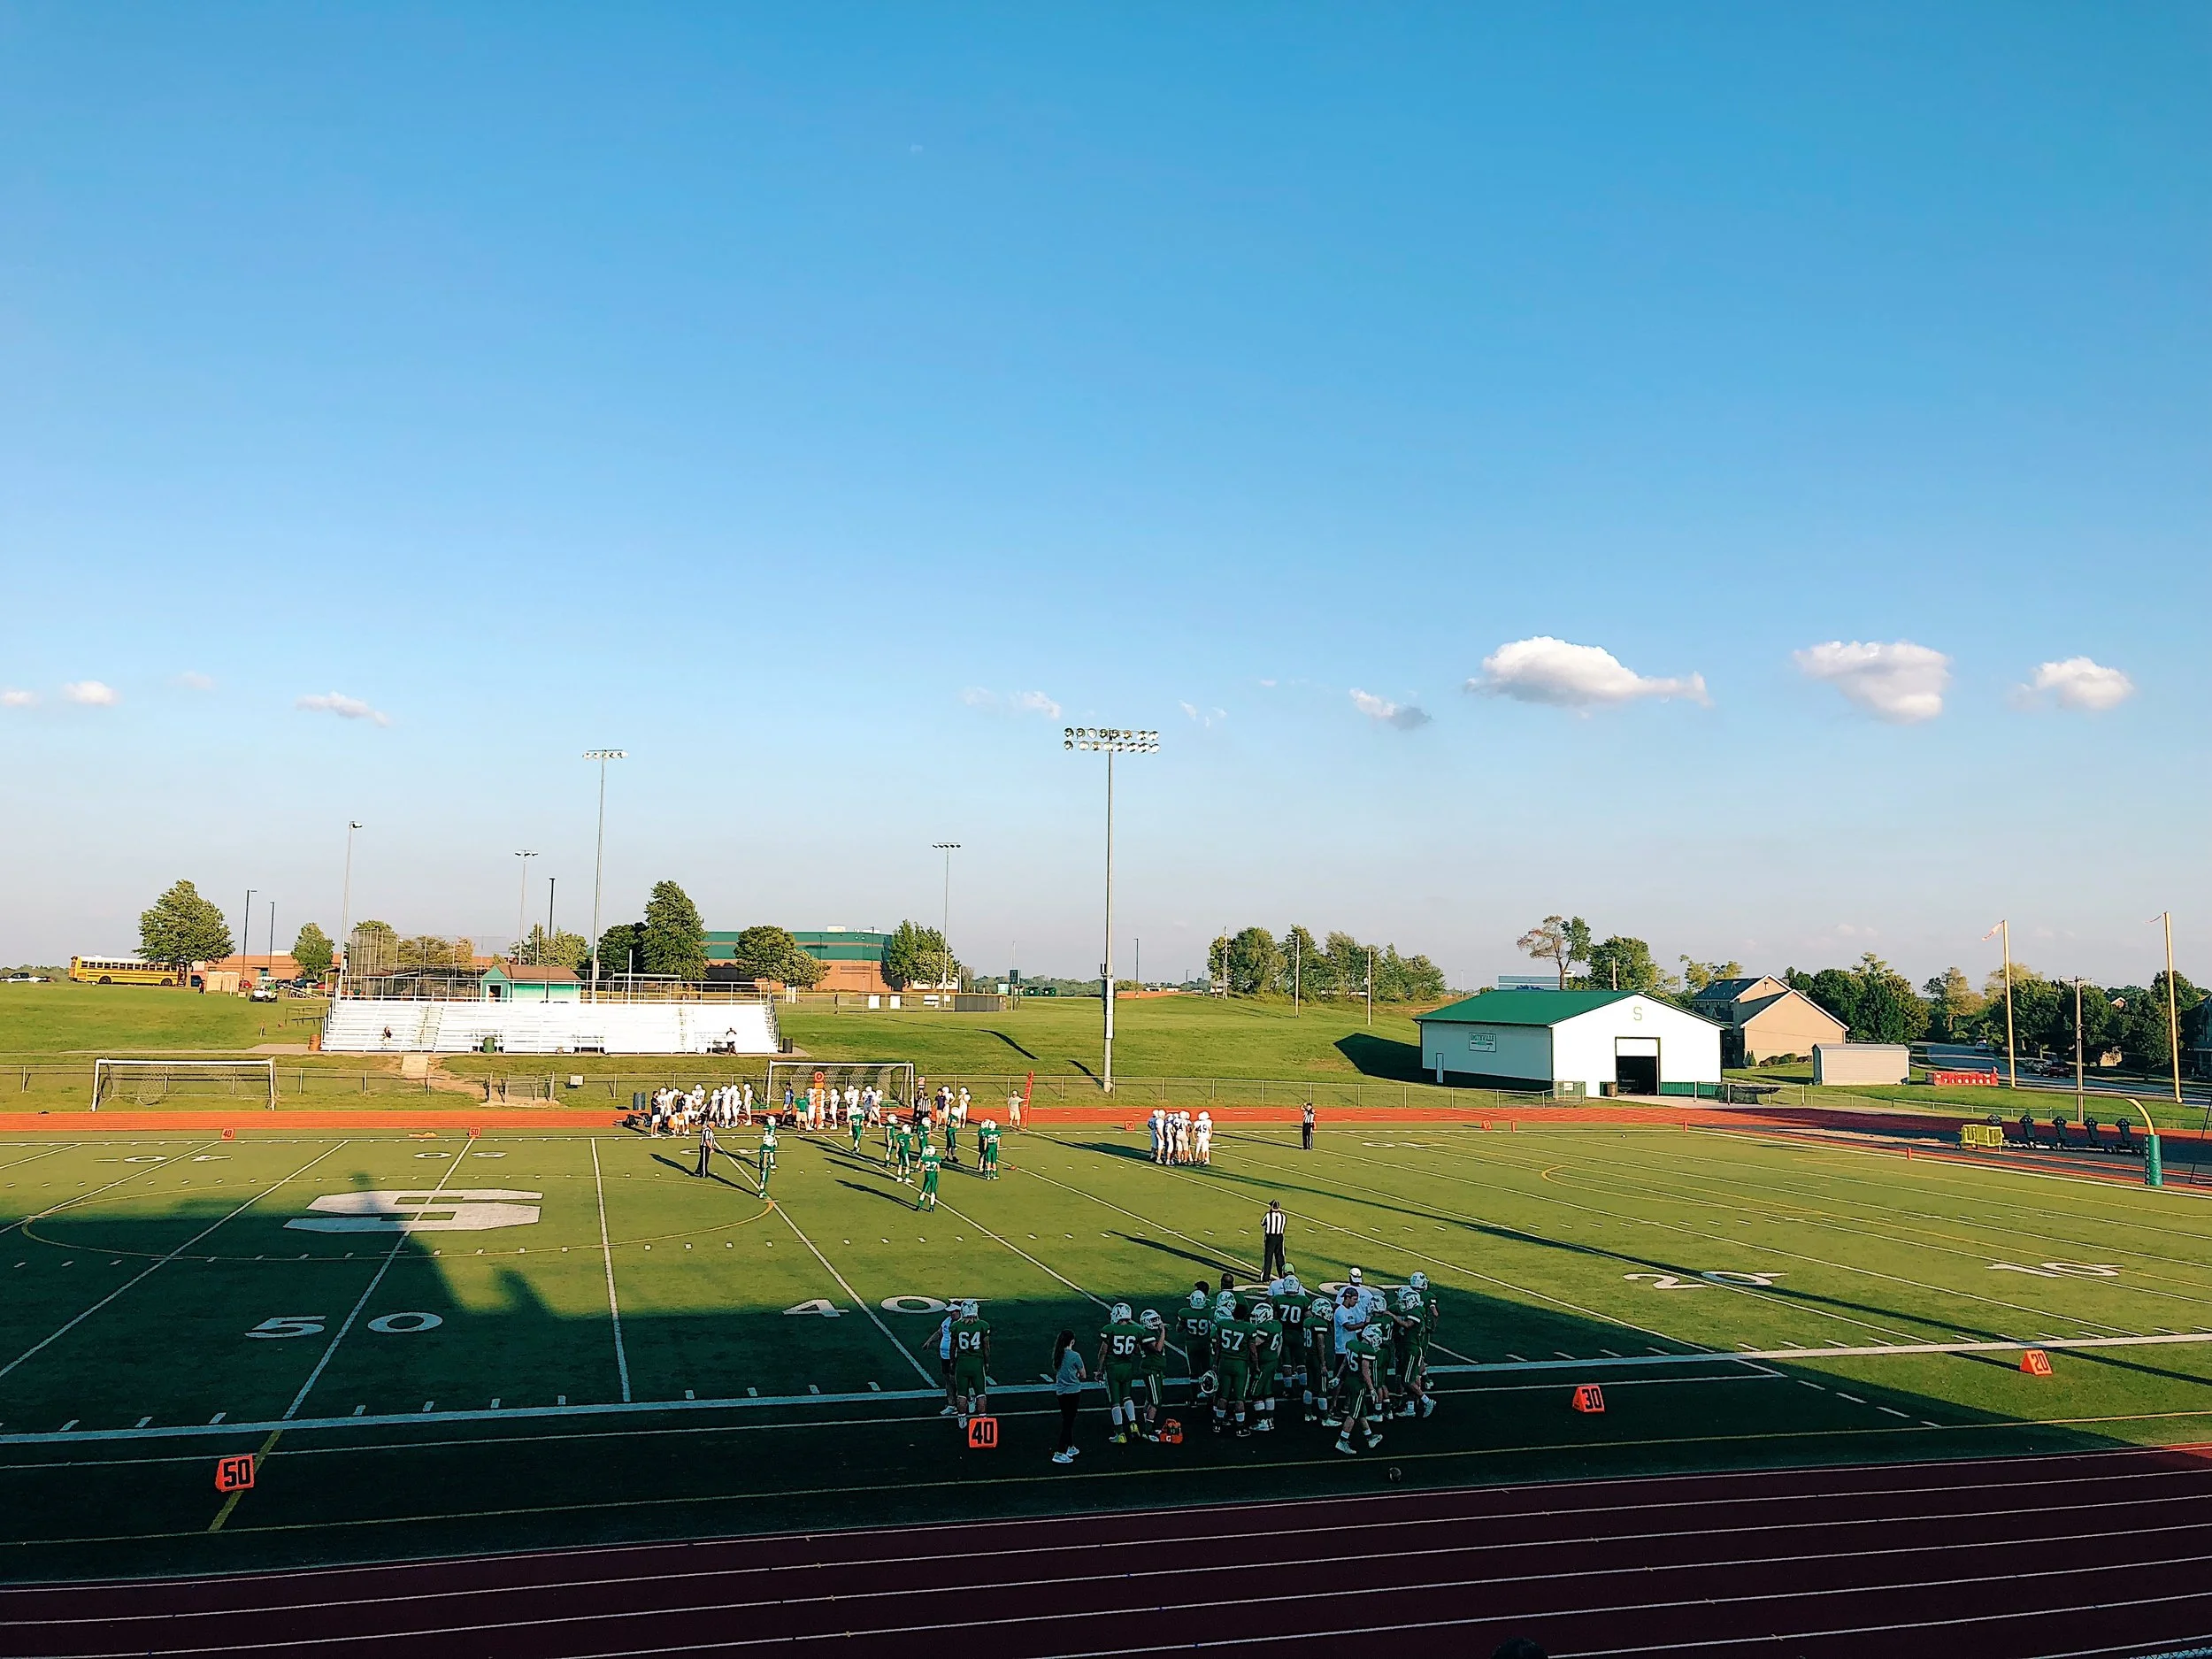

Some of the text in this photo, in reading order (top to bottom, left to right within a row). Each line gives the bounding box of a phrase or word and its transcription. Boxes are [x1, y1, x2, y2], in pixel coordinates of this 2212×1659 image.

[1633, 1006, 1642, 1020] S
[283, 1189, 543, 1233] S
[1279, 1304, 1302, 1323] 70
[1187, 1318, 1209, 1335] 59
[958, 1331, 980, 1350] 64
[1112, 1335, 1136, 1355] 56
[1221, 1328, 1244, 1351] 57
[2031, 1353, 2049, 1371] 20
[1582, 1387, 1602, 1409] 30
[971, 1420, 995, 1444] 40
[223, 1458, 251, 1487] 50
